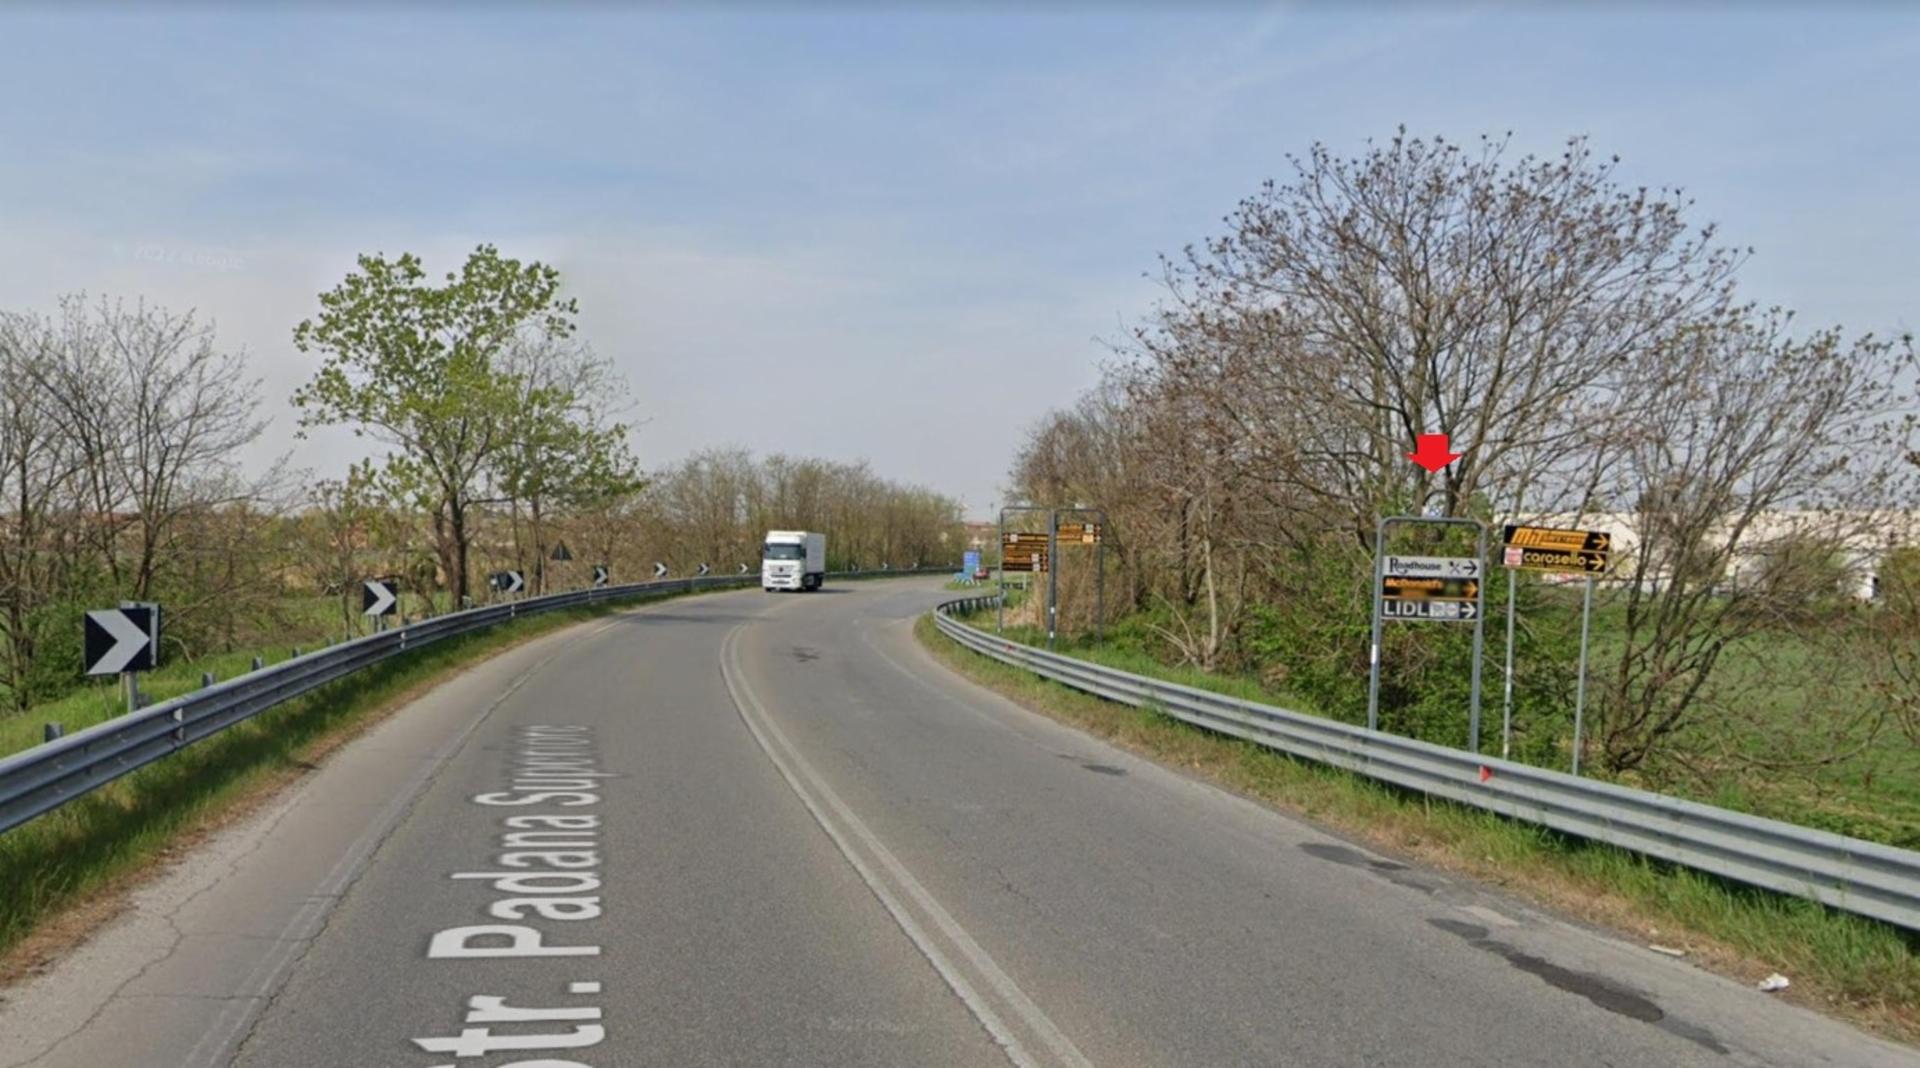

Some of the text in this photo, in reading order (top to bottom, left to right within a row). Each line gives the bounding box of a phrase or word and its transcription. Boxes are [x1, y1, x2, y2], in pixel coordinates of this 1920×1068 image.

[1389, 557, 1442, 575] Roadhouse
[1523, 550, 1587, 566] carosello
[1383, 601, 1429, 617] LIDL
